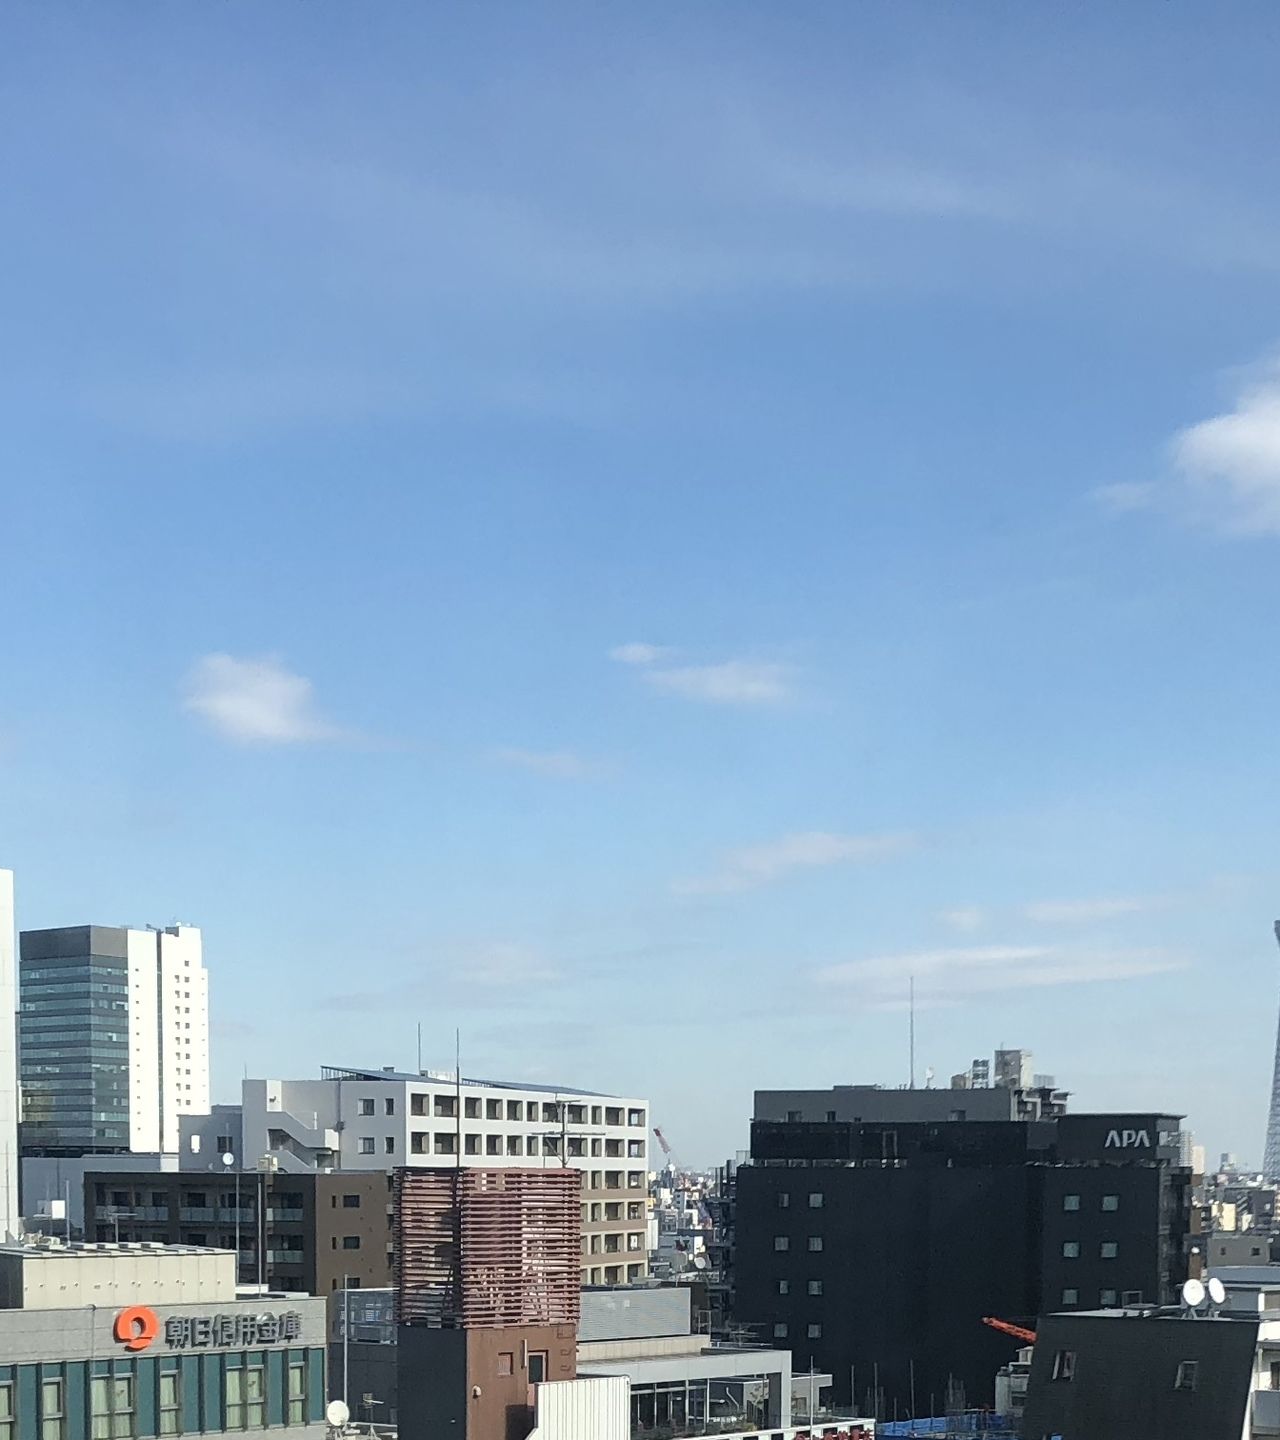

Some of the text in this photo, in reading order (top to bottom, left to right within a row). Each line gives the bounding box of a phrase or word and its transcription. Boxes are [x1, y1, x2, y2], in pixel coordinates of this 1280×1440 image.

[1104, 1129, 1151, 1148] APA
[164, 1310, 303, 1350] 朝日信用金庫
